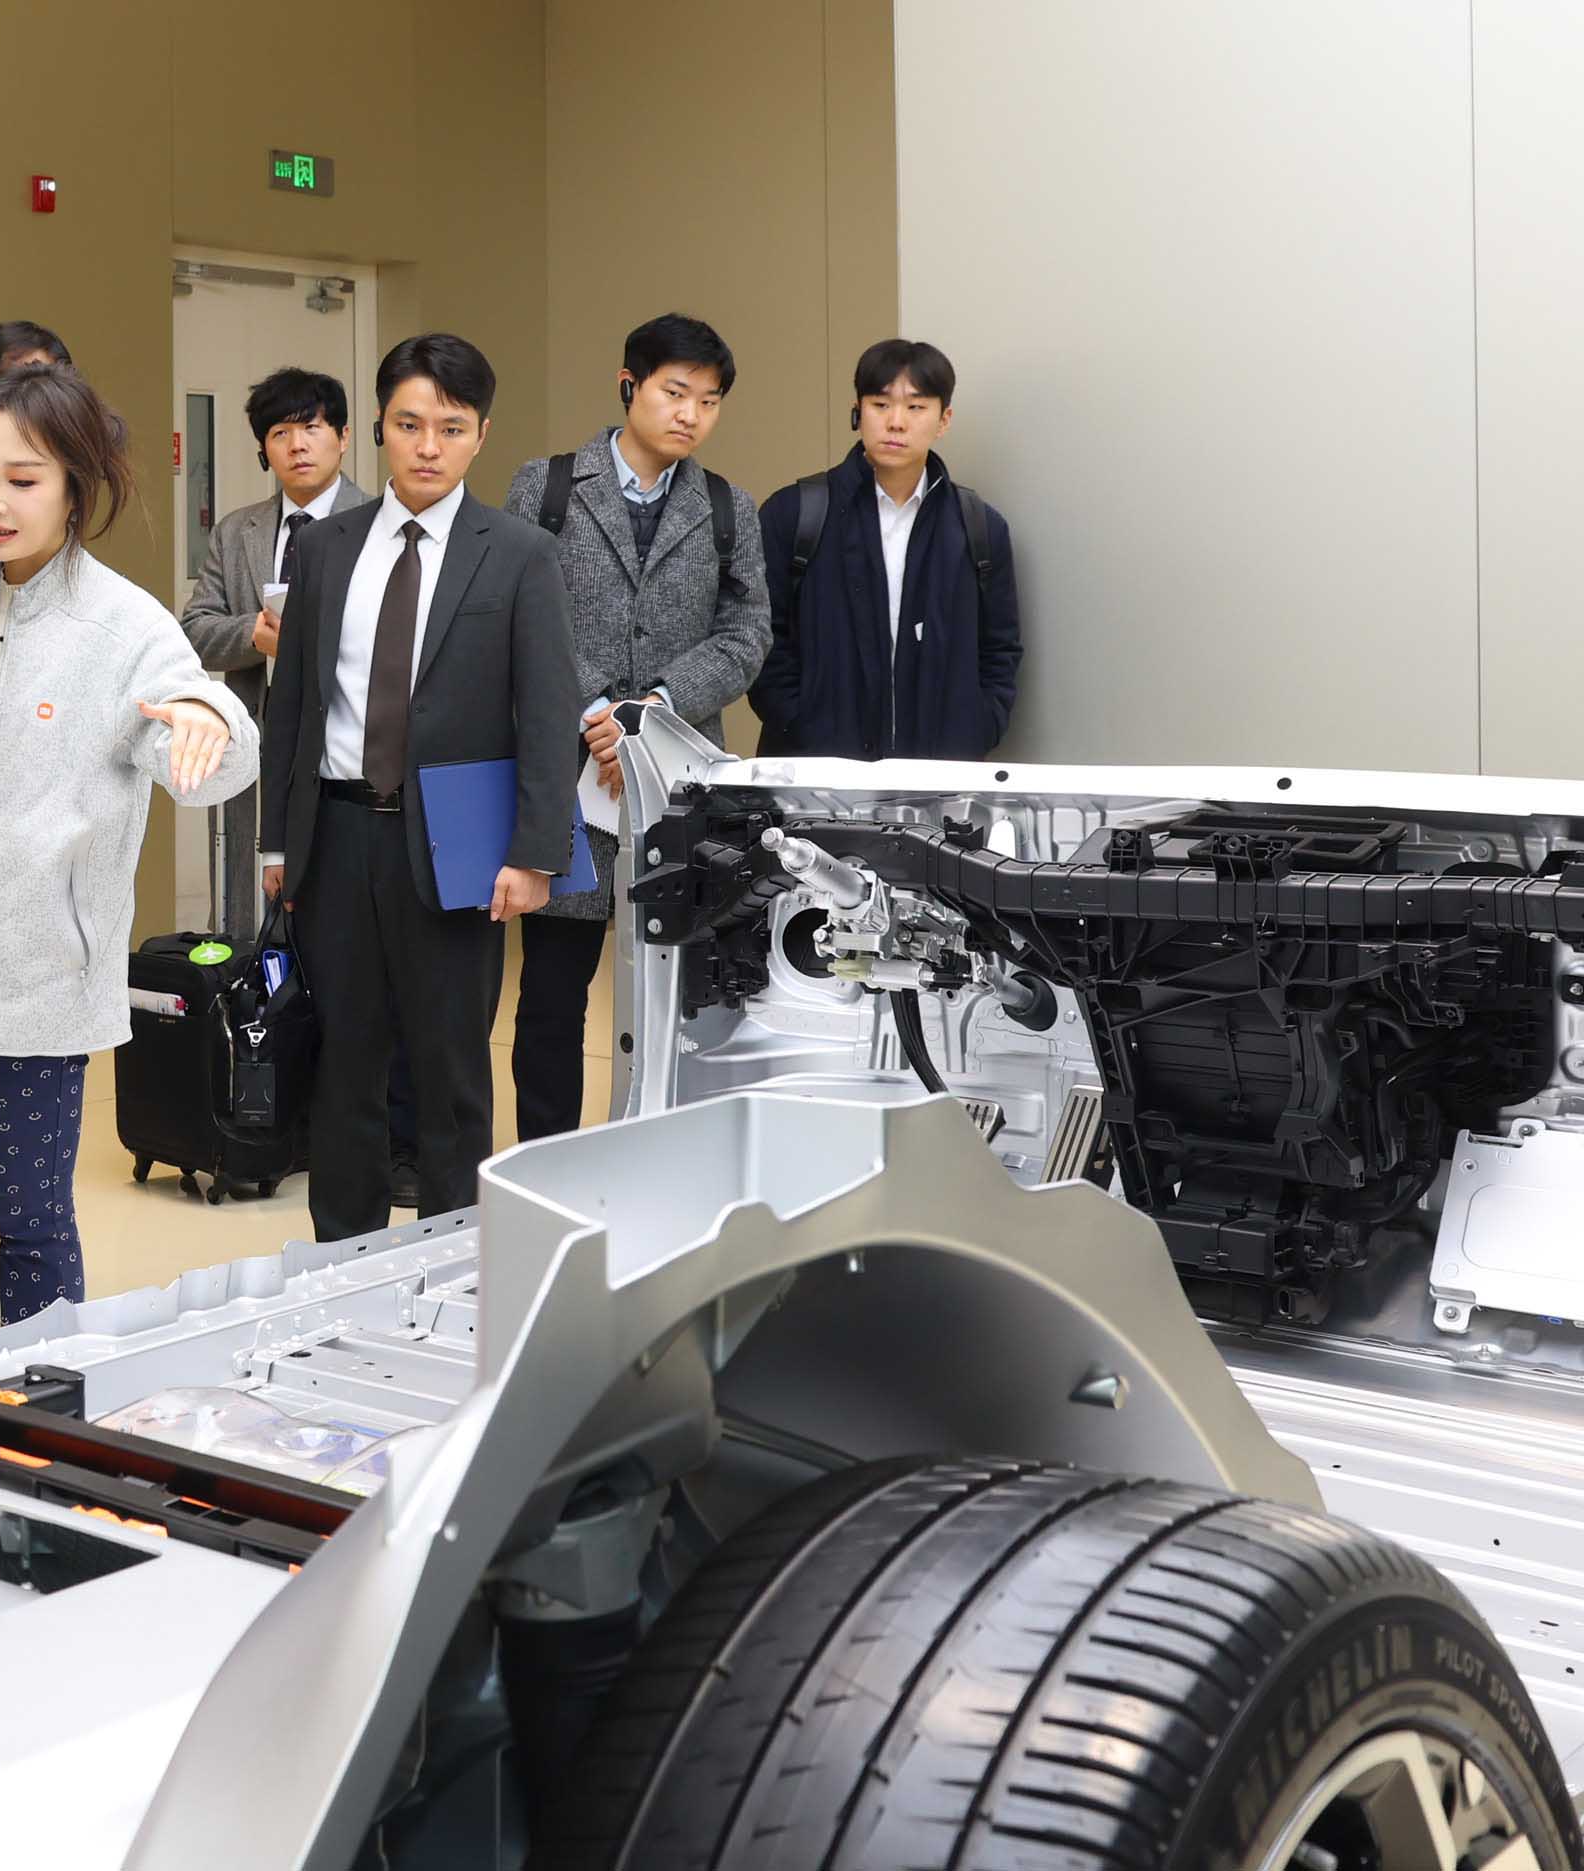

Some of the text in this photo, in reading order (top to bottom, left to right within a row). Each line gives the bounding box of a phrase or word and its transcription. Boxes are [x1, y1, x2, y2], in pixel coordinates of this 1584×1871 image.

[1233, 1624, 1541, 1843] MICHELIN PILOT SPORT
